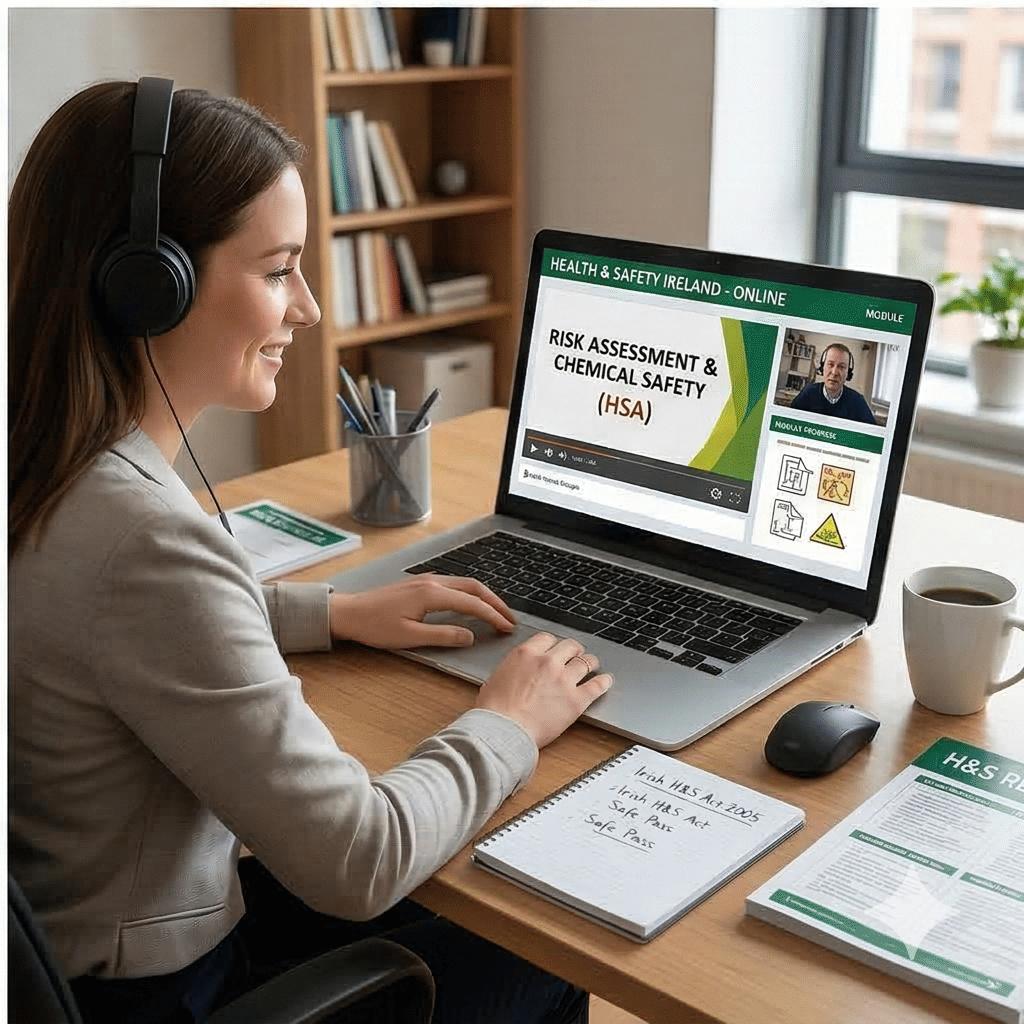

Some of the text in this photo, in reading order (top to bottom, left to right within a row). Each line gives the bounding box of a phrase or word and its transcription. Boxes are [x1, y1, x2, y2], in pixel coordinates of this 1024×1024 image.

[550, 256, 599, 279] HEALTH
[600, 264, 610, 280] &
[612, 266, 660, 287] SAFETY
[663, 273, 721, 297] IRELAND
[733, 286, 788, 308] ONLINE
[549, 328, 718, 377] RISK ASSESSMENT &
[553, 354, 707, 400] CHEMICAL SAFETY
[597, 391, 653, 426] (HSA)
[942, 751, 999, 781] H&S
[634, 765, 765, 824] Irish H&S Act 2005
[608, 799, 675, 834] Safe Pass
[684, 814, 711, 831] Act
[622, 827, 656, 850] Pass
